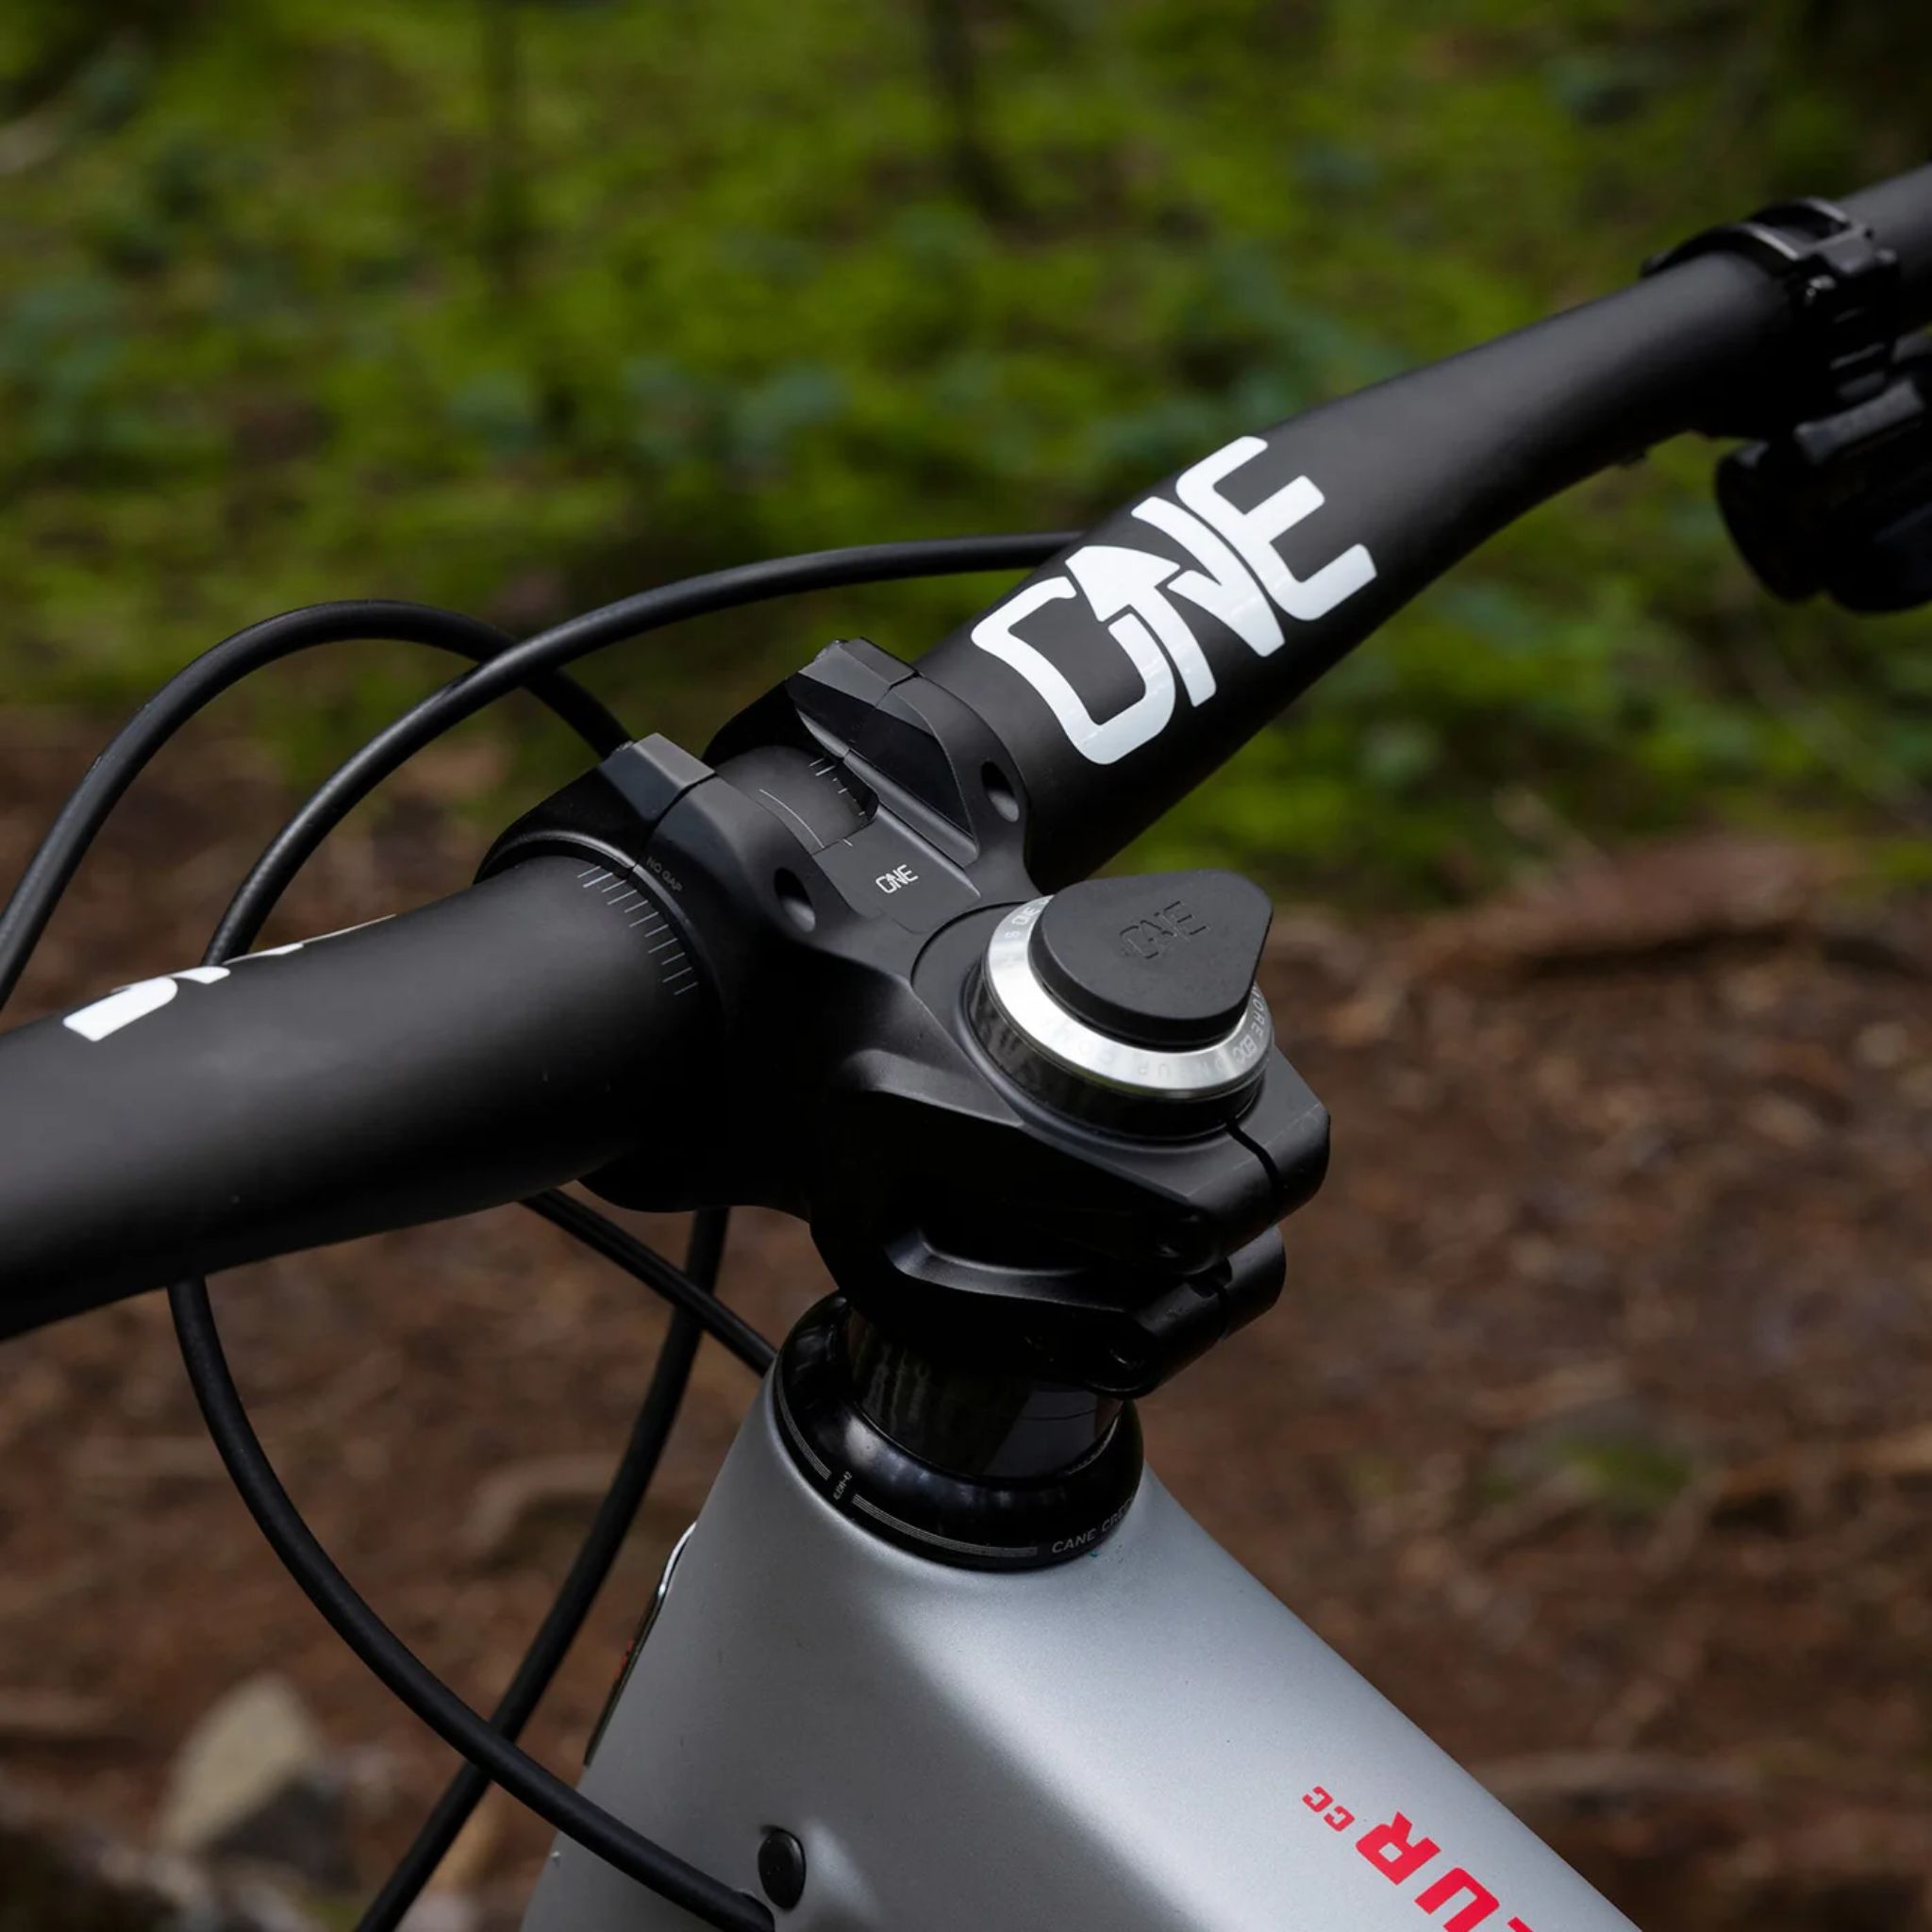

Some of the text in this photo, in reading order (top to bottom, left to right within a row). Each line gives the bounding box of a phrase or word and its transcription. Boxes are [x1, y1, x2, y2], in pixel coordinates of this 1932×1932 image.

[1052, 1527, 1097, 1554] CANE
[1302, 1786, 1535, 1932] UR CC
